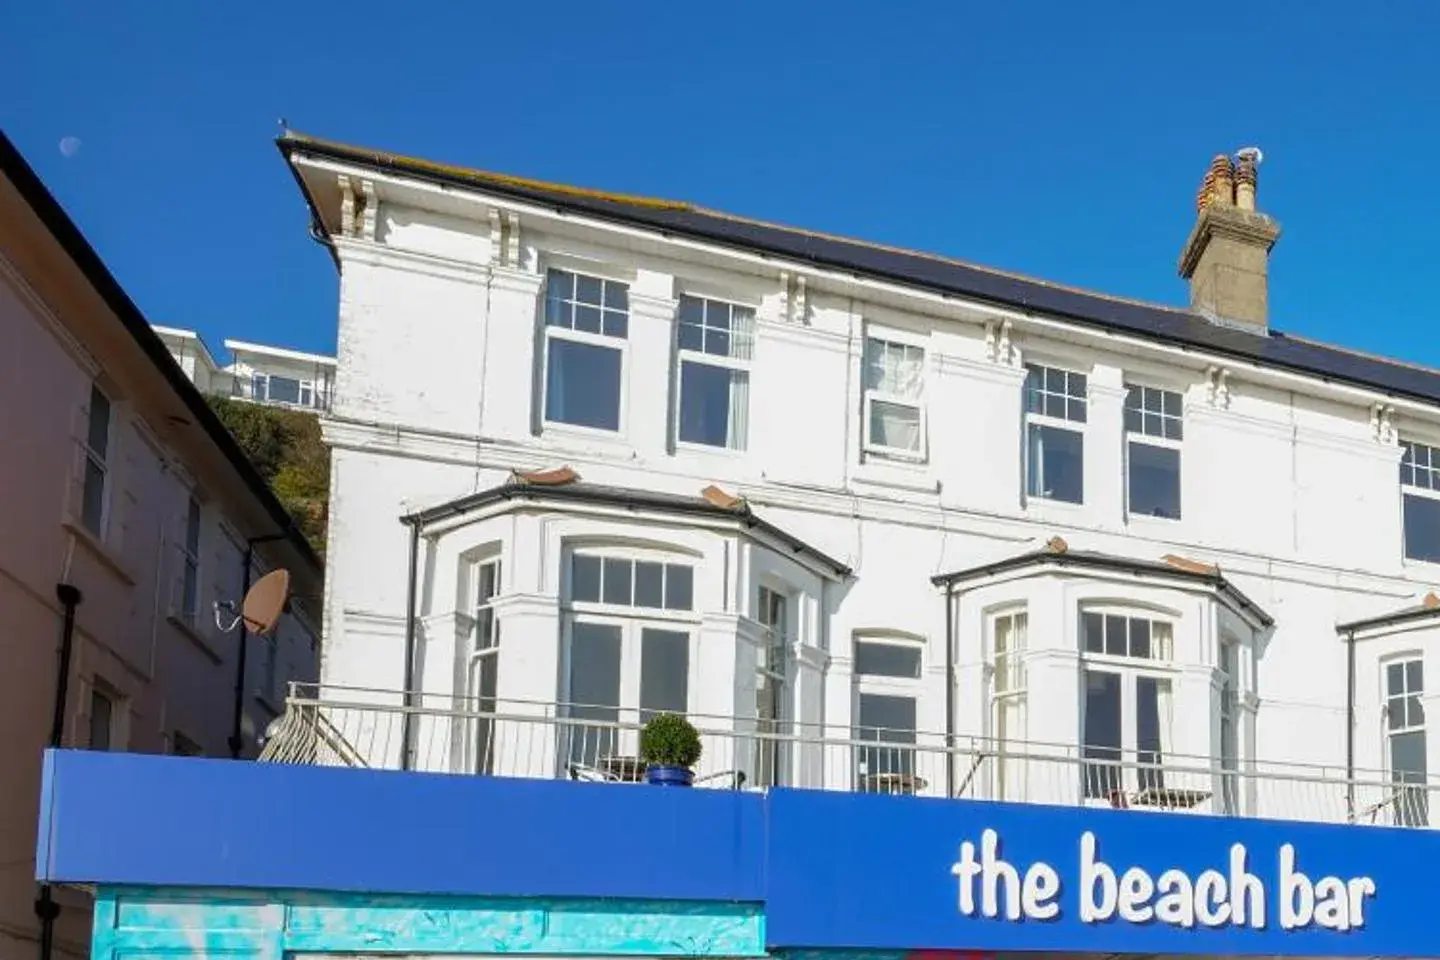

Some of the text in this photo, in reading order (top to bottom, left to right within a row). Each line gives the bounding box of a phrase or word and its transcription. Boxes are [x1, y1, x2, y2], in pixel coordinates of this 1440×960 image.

[952, 829, 1375, 930] the beach bar
